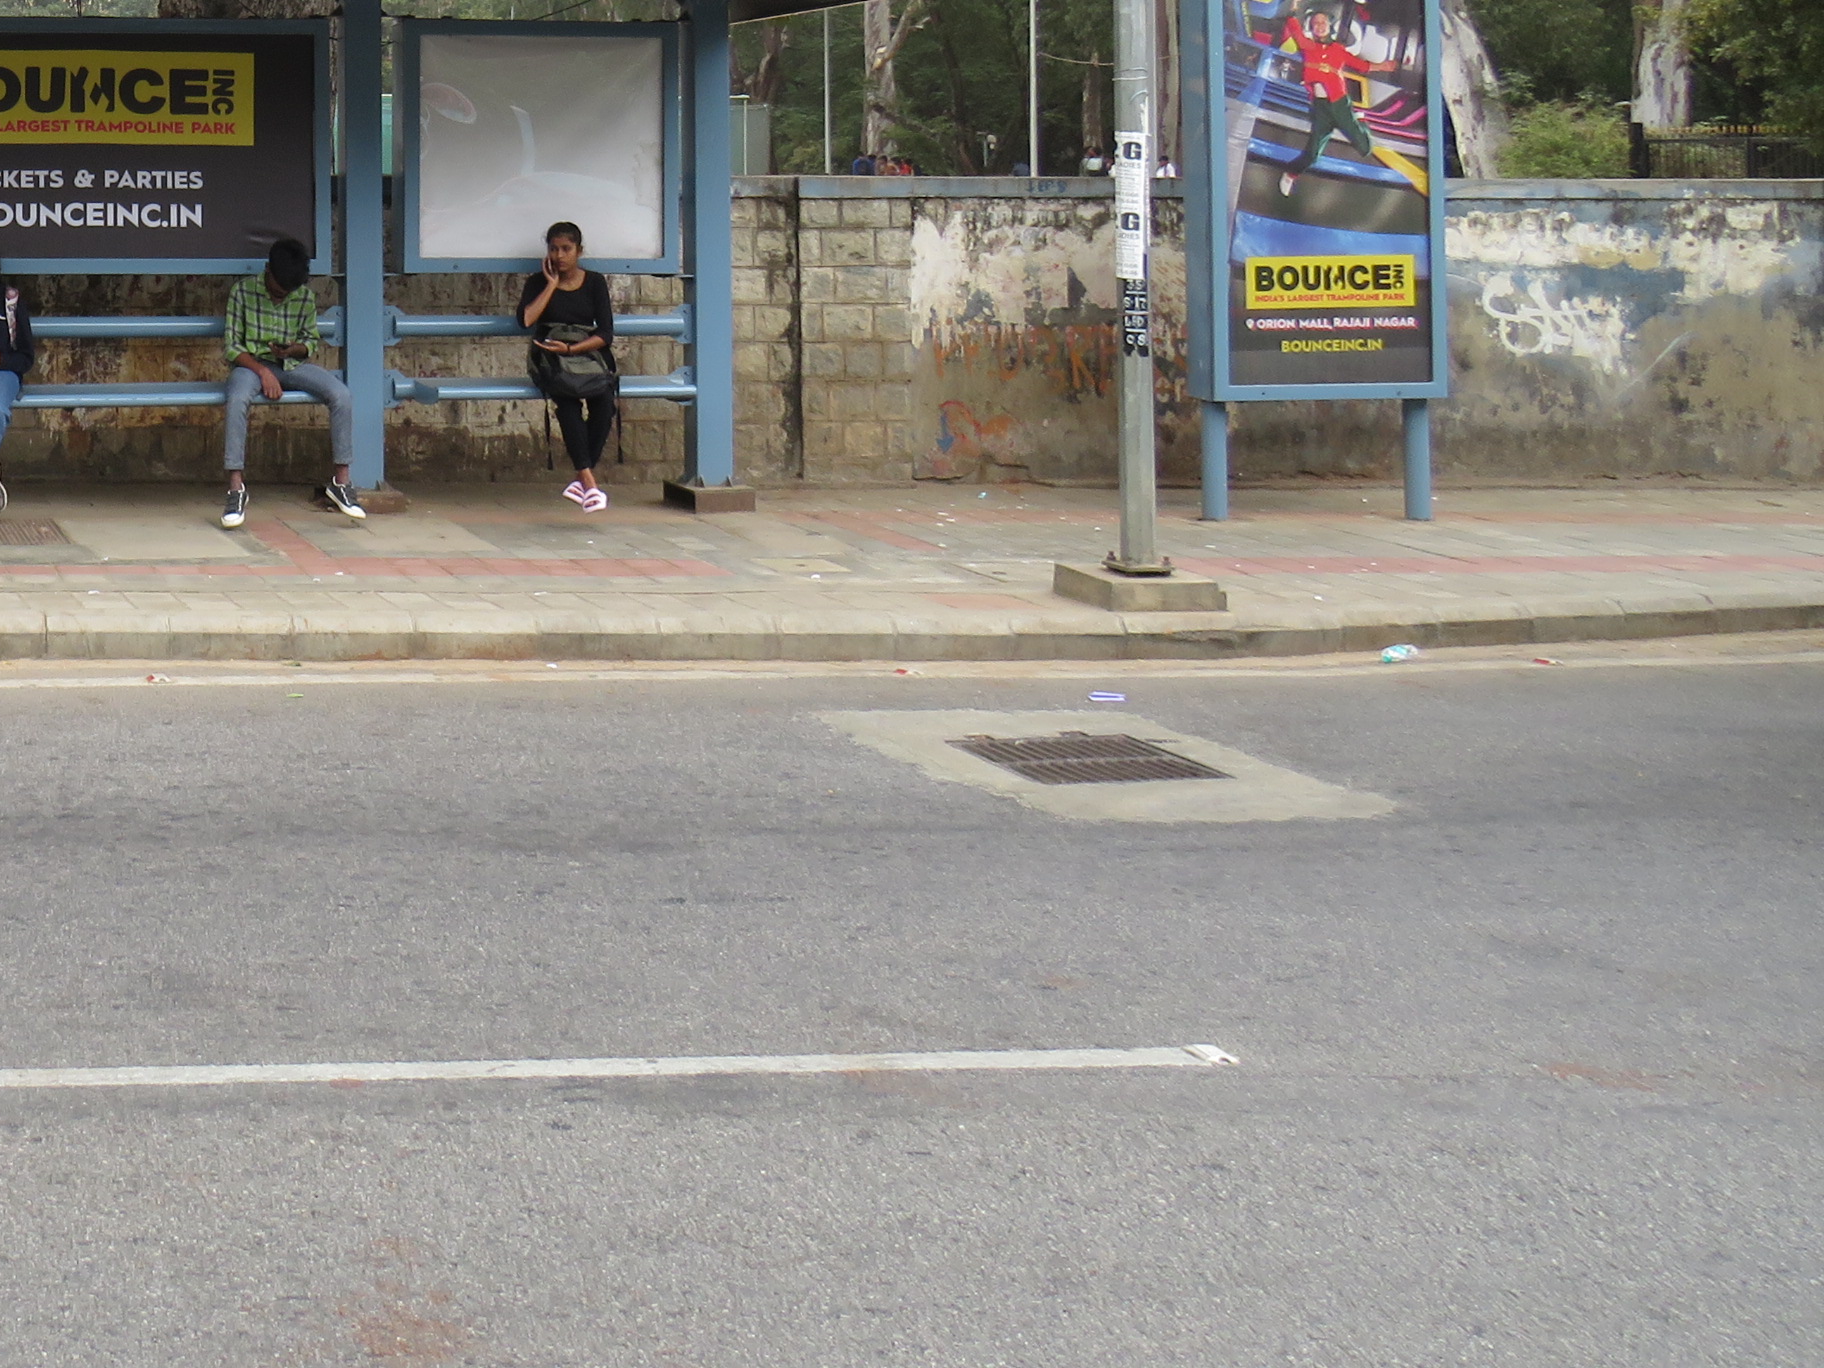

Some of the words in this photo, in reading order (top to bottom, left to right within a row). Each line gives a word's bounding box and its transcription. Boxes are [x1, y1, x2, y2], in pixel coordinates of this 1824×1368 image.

[211, 69, 236, 116] INC
[74, 120, 184, 134] TRAMPOLINE
[191, 122, 236, 135] PARK
[73, 169, 95, 188] &
[104, 170, 204, 190] PARTIES
[1255, 264, 1392, 292] BOUNCE
[1382, 293, 1406, 301] PARK
[1256, 318, 1296, 330] ORION
[1333, 317, 1372, 330] RAJAJI
[1373, 316, 1417, 329] NAGAR
[1280, 338, 1384, 353] BOUNCEINC.IN
